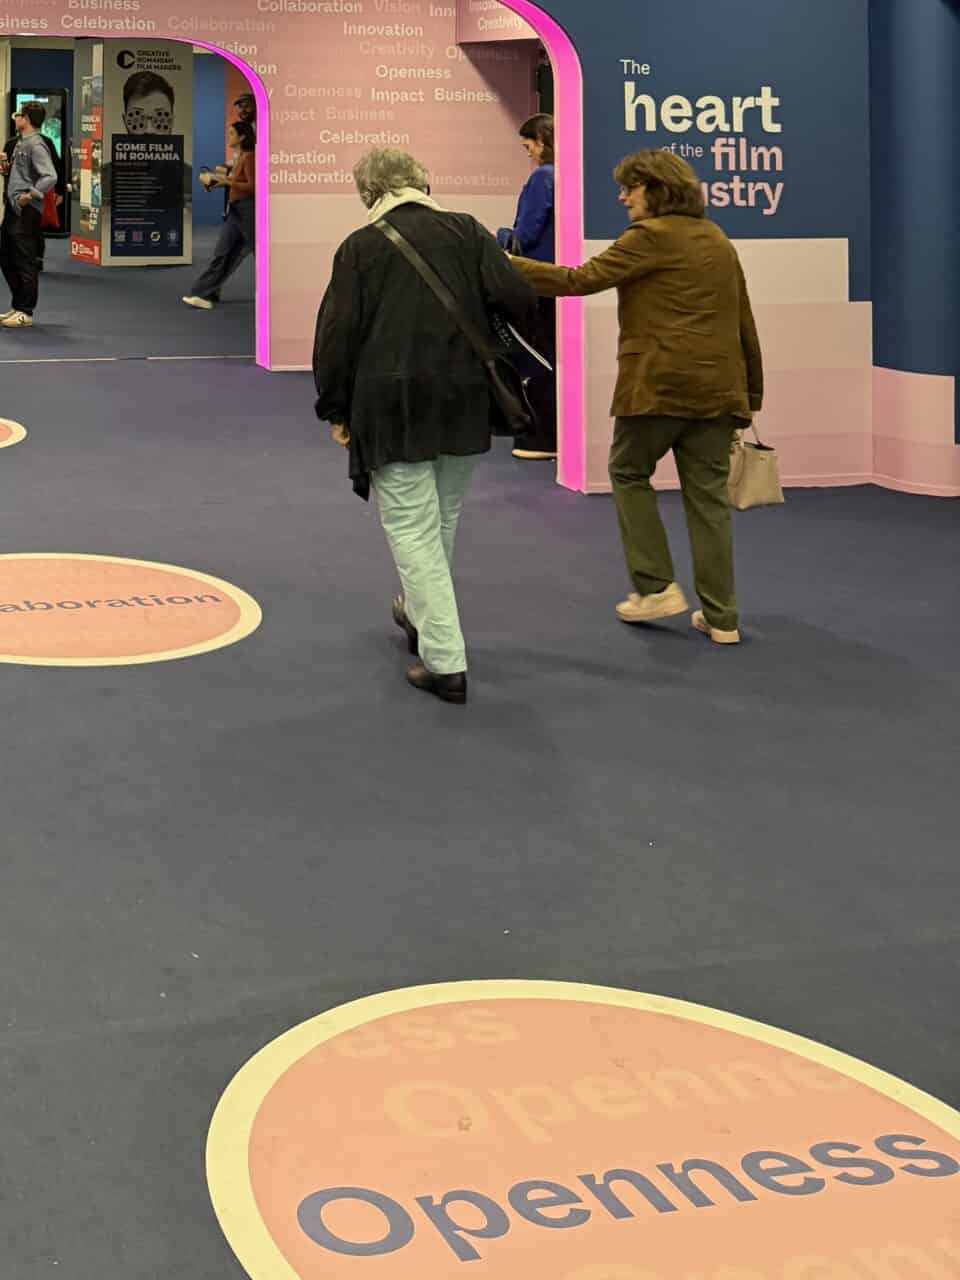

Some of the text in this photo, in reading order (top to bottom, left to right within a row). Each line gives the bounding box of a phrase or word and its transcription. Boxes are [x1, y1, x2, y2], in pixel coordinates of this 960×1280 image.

[60, 15, 157, 32] Celebration
[343, 21, 424, 37] Innovation
[375, 63, 452, 81] Openness
[619, 58, 650, 75] The
[371, 86, 425, 104] Impact
[624, 81, 782, 133] heart
[319, 128, 411, 145] Celebration
[115, 143, 174, 152] COME FILM
[679, 143, 704, 158] the
[710, 137, 783, 172] film
[115, 152, 180, 161] IN ROMANIA
[296, 1133, 960, 1262] Openness
